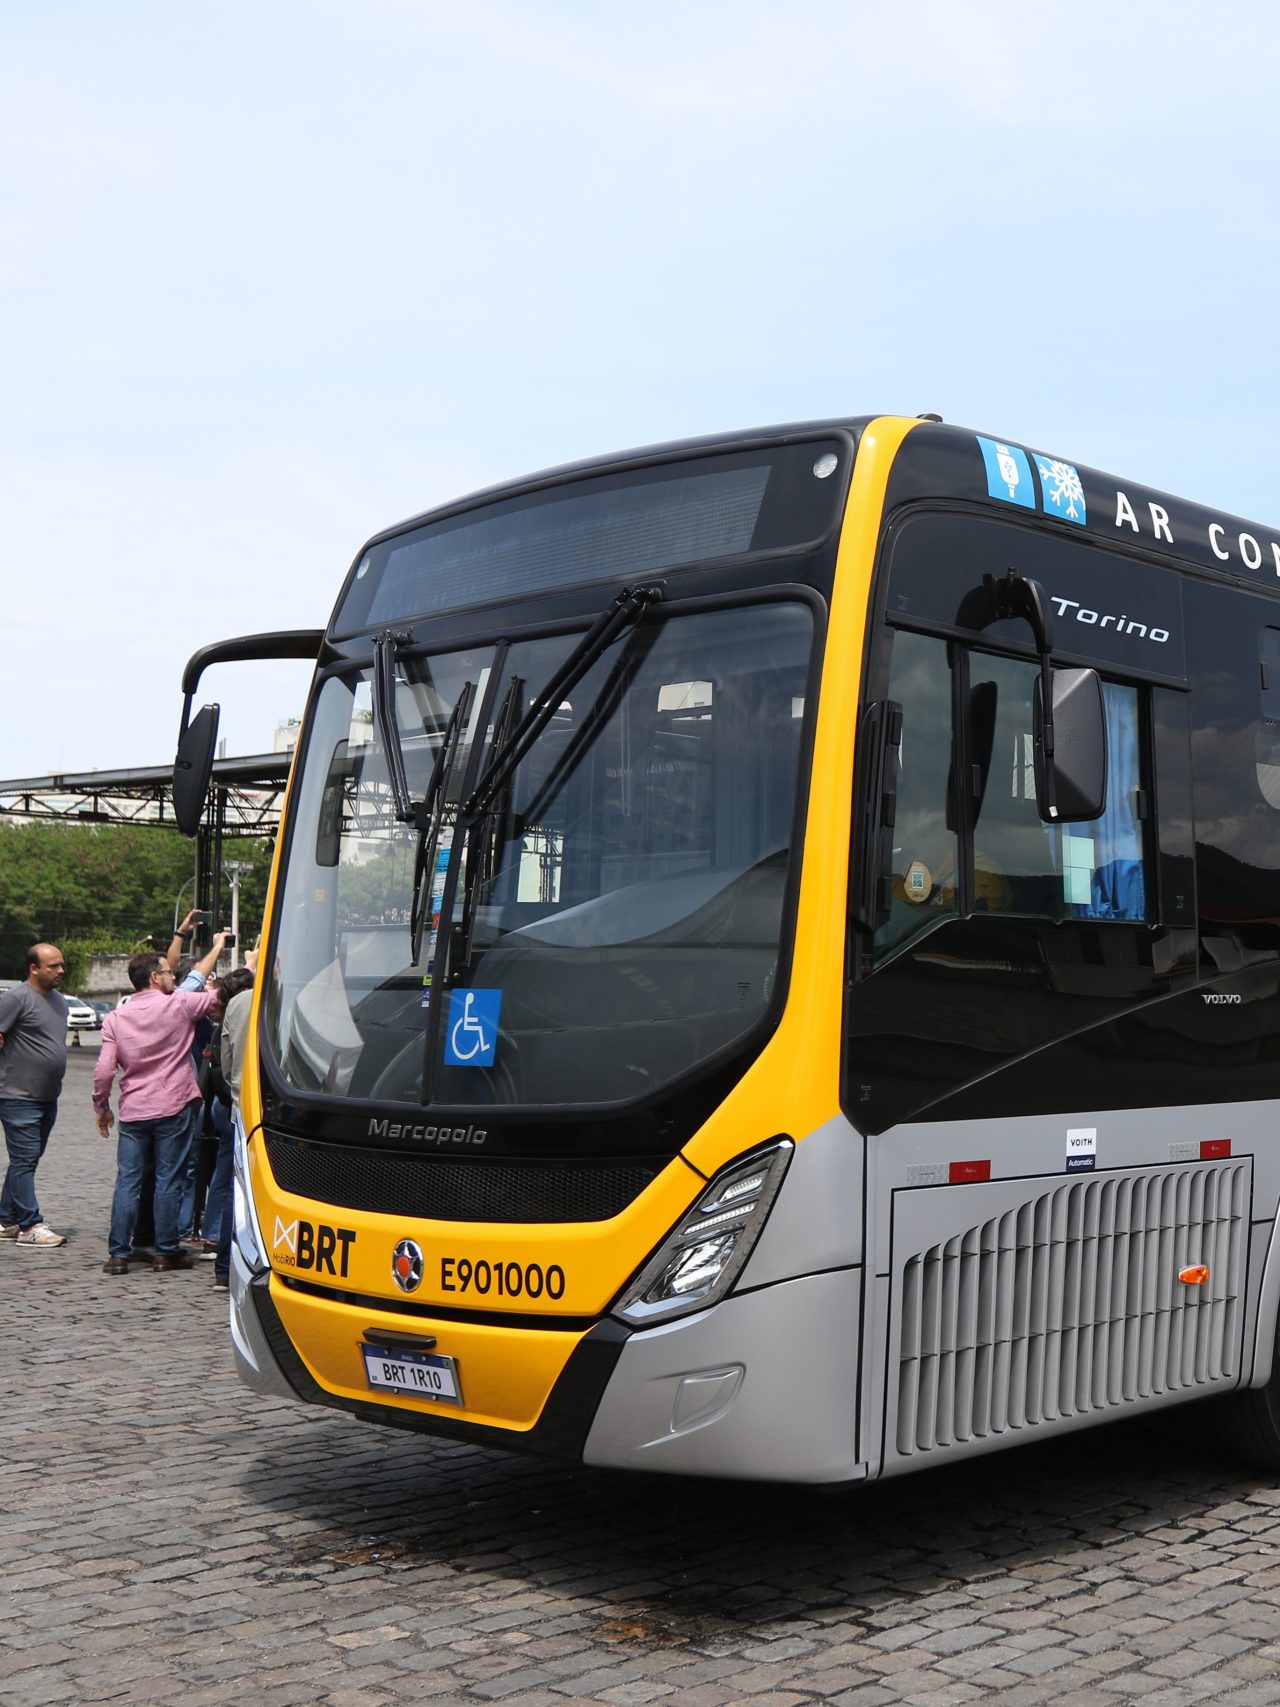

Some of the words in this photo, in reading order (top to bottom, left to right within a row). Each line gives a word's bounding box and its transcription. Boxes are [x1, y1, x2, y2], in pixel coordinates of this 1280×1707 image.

[1115, 491, 1174, 544] AR
[1051, 596, 1170, 643] Torino
[1201, 994, 1242, 1004] VOLVO
[368, 1118, 487, 1145] Marcopolo
[1070, 1138, 1093, 1147] VOITH
[1068, 1158, 1093, 1167] Automatic
[272, 1253, 296, 1266] MobiRIO
[296, 1220, 356, 1278] BRT
[441, 1257, 566, 1300] E901000
[382, 1363, 406, 1384] BRT
[410, 1367, 442, 1390] 1R10
